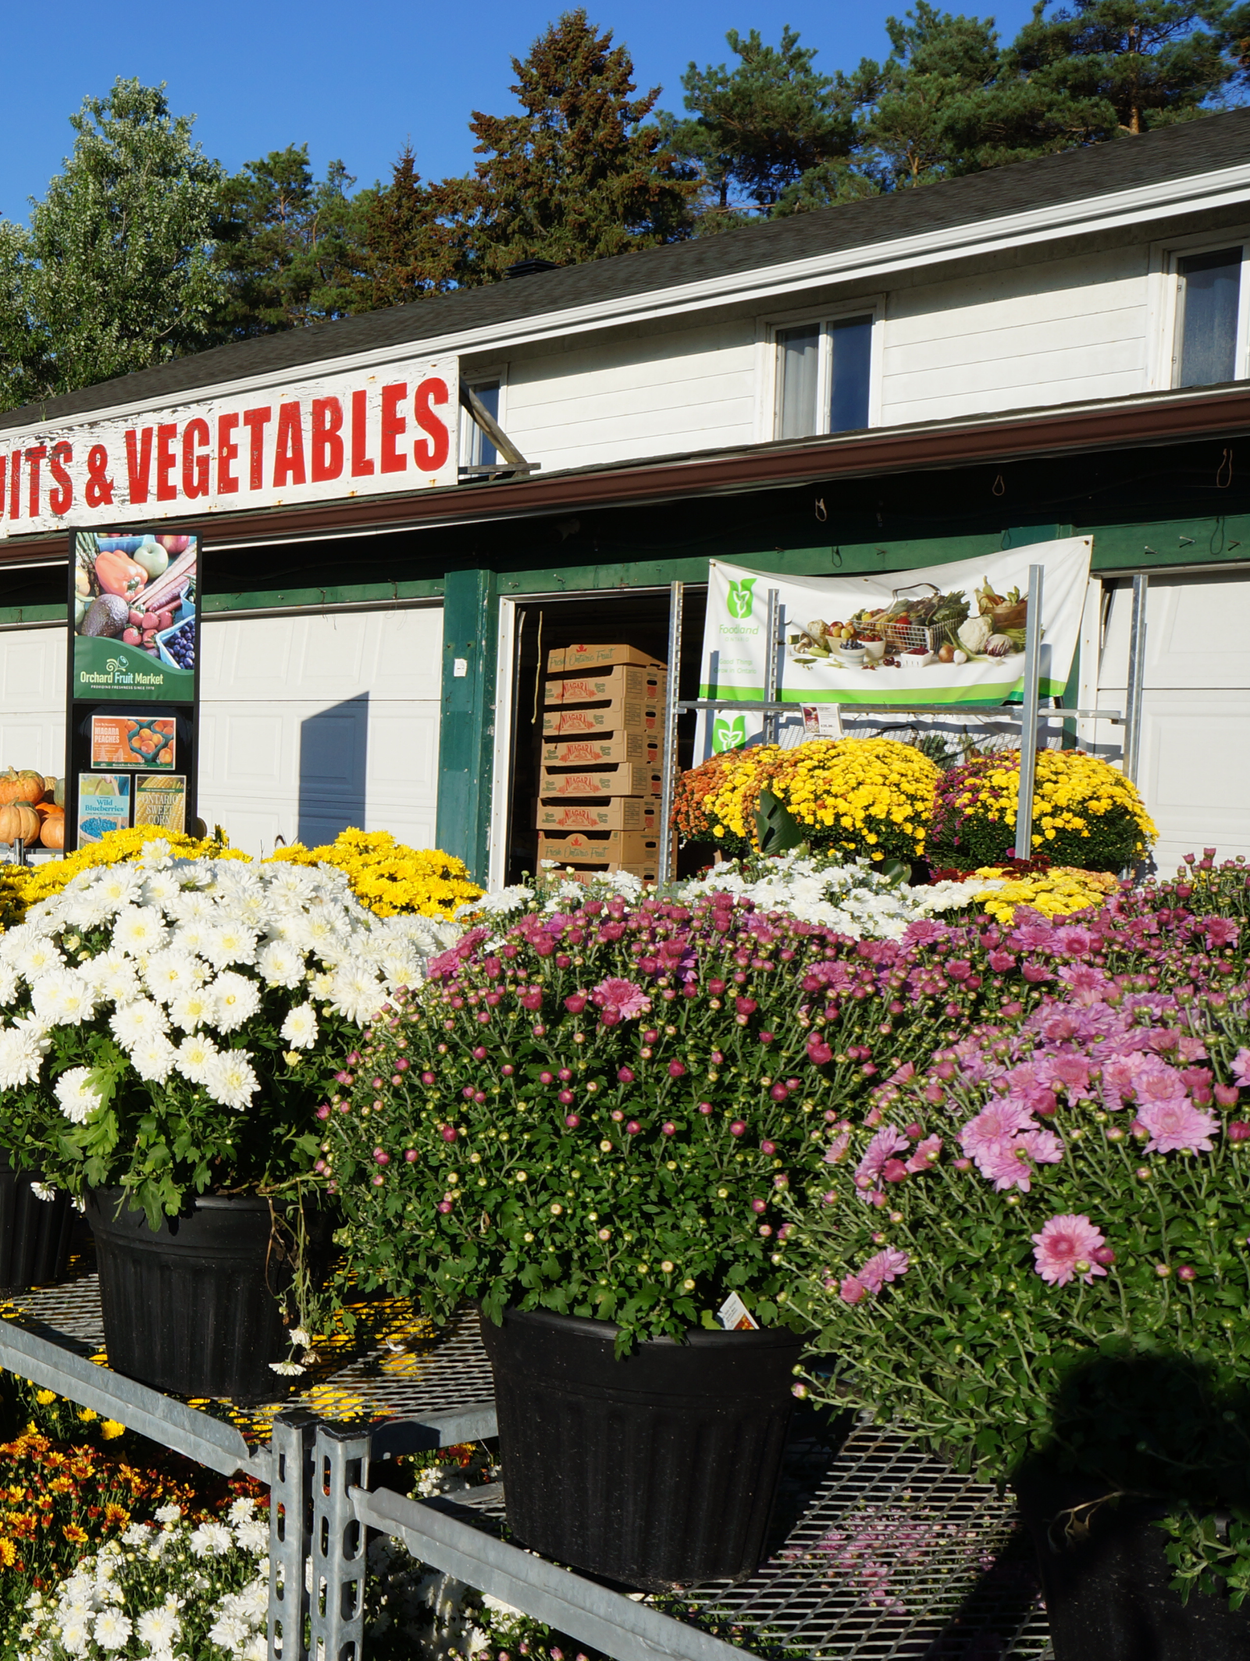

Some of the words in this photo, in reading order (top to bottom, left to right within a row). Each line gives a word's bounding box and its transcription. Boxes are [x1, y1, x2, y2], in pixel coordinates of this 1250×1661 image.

[85, 444, 116, 509] &
[125, 377, 450, 505] VEGETABLES
[719, 624, 760, 635] Foodland
[80, 671, 113, 684] Orchard
[114, 672, 134, 684] Fruit
[135, 672, 164, 685] Market
[94, 735, 120, 744] PEACHES
[96, 798, 113, 806] Wild
[141, 795, 178, 805] ONTARIO
[85, 804, 124, 813] Blueberries
[146, 804, 173, 815] SWEET
[148, 814, 171, 825] CORN
